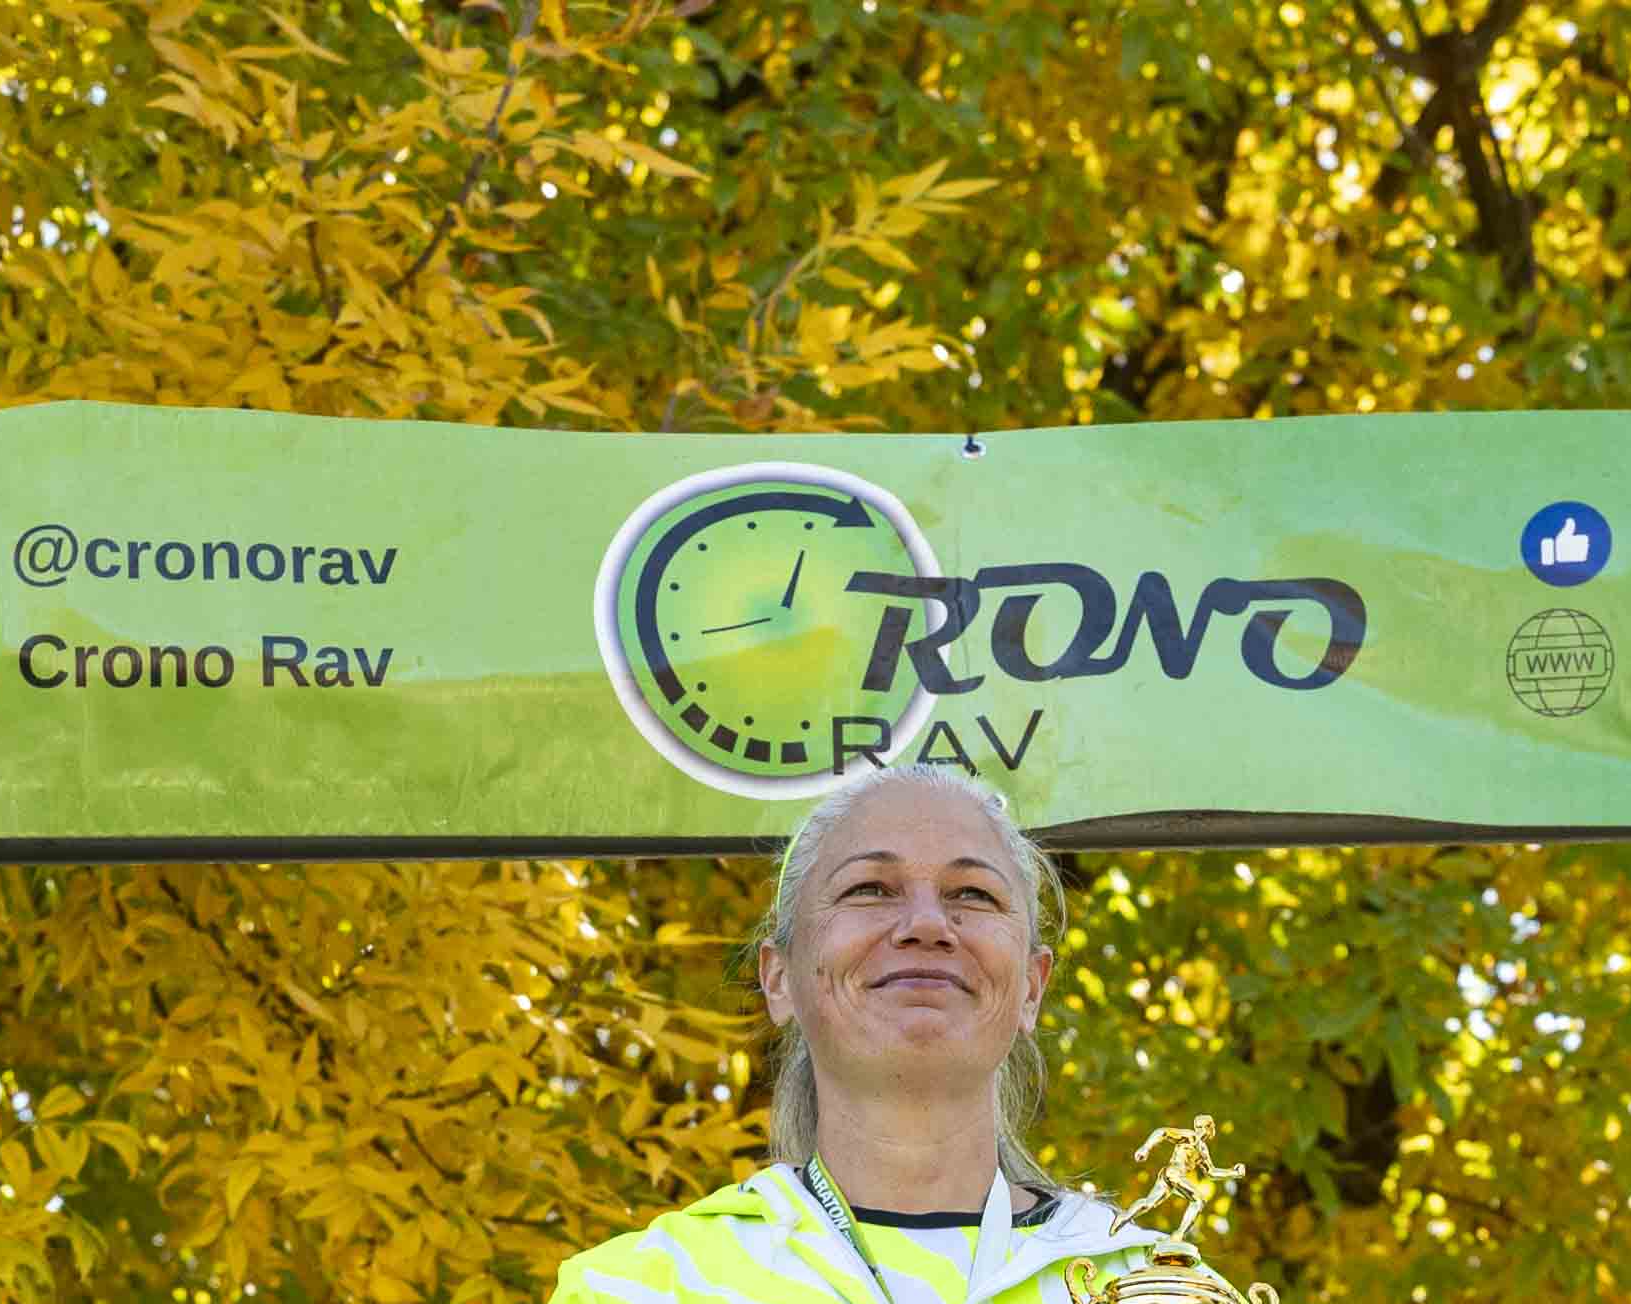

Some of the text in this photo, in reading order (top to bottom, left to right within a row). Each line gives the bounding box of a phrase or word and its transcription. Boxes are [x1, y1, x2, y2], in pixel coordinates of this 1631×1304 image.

[13, 523, 398, 588] @cronorav
[18, 634, 394, 688] Crono Rav
